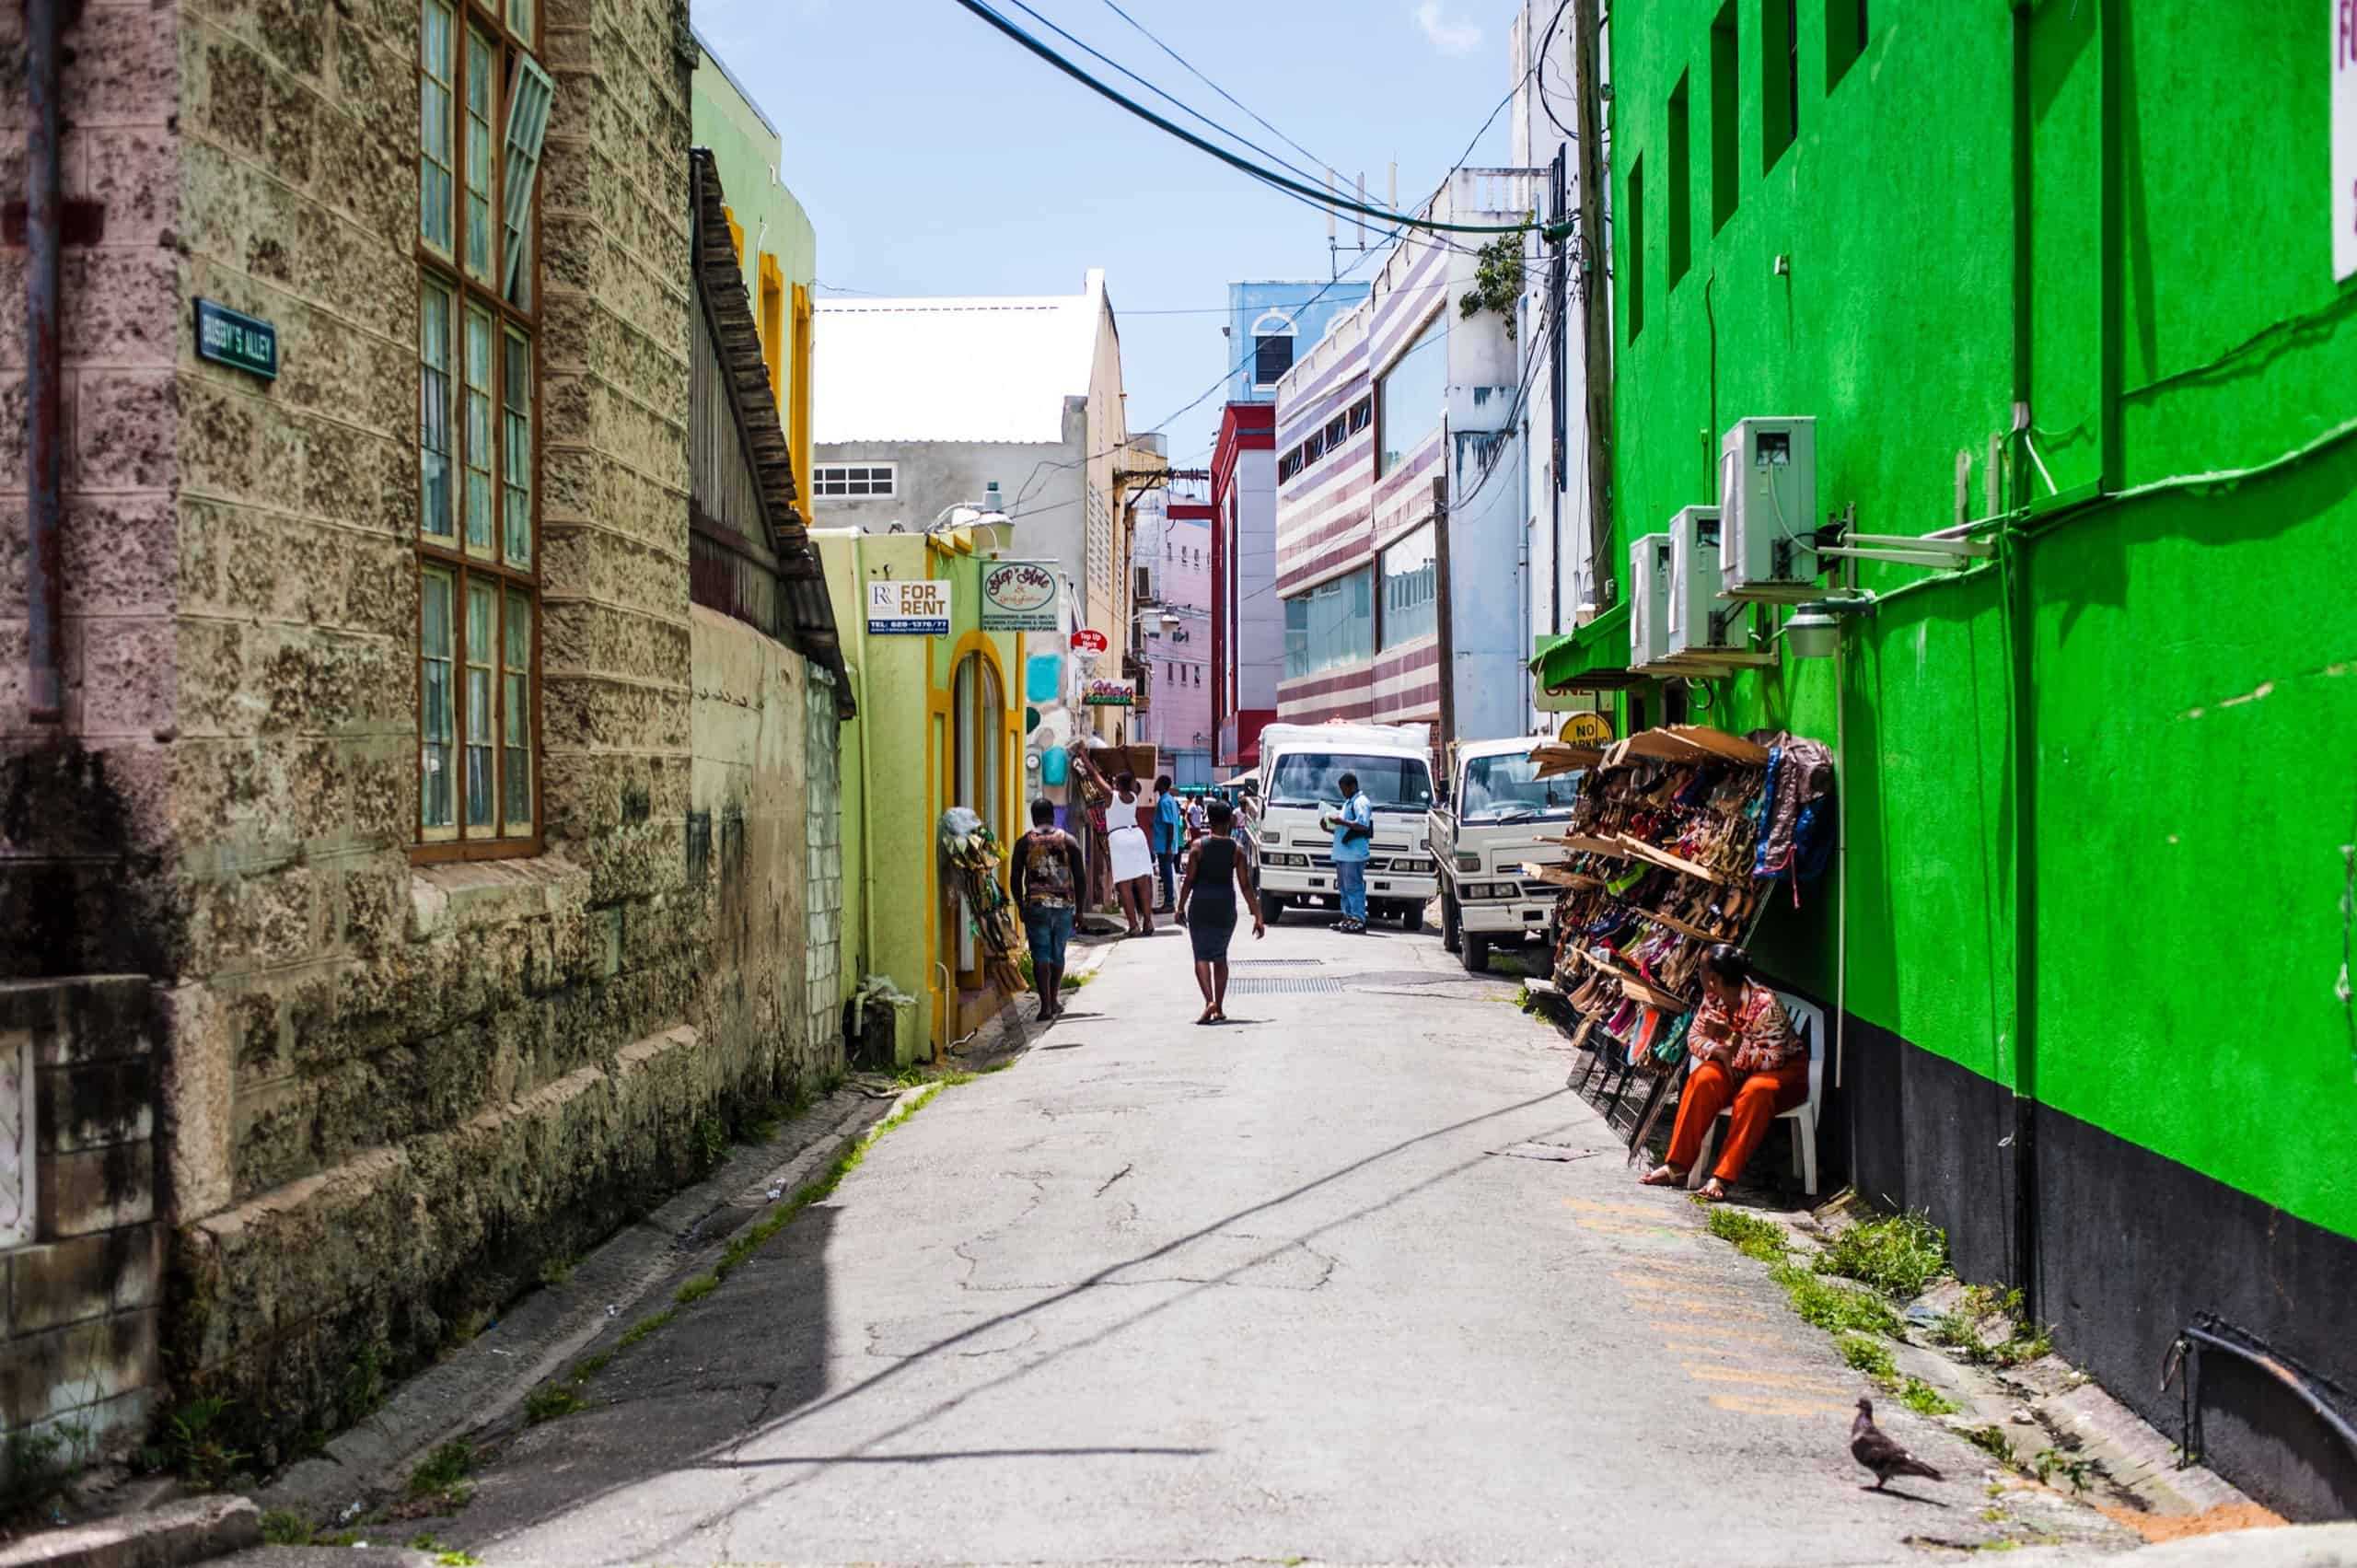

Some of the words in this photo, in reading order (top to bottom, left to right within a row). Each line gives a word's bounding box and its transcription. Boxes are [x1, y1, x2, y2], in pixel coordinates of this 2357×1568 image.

[203, 314, 242, 354] BUSBY'S
[245, 330, 271, 362] ALLEY
[901, 585, 936, 599] FOR
[901, 600, 946, 615] RENT
[1081, 633, 1091, 641] Top
[1092, 633, 1102, 642] Up
[1575, 724, 1595, 737] NO
